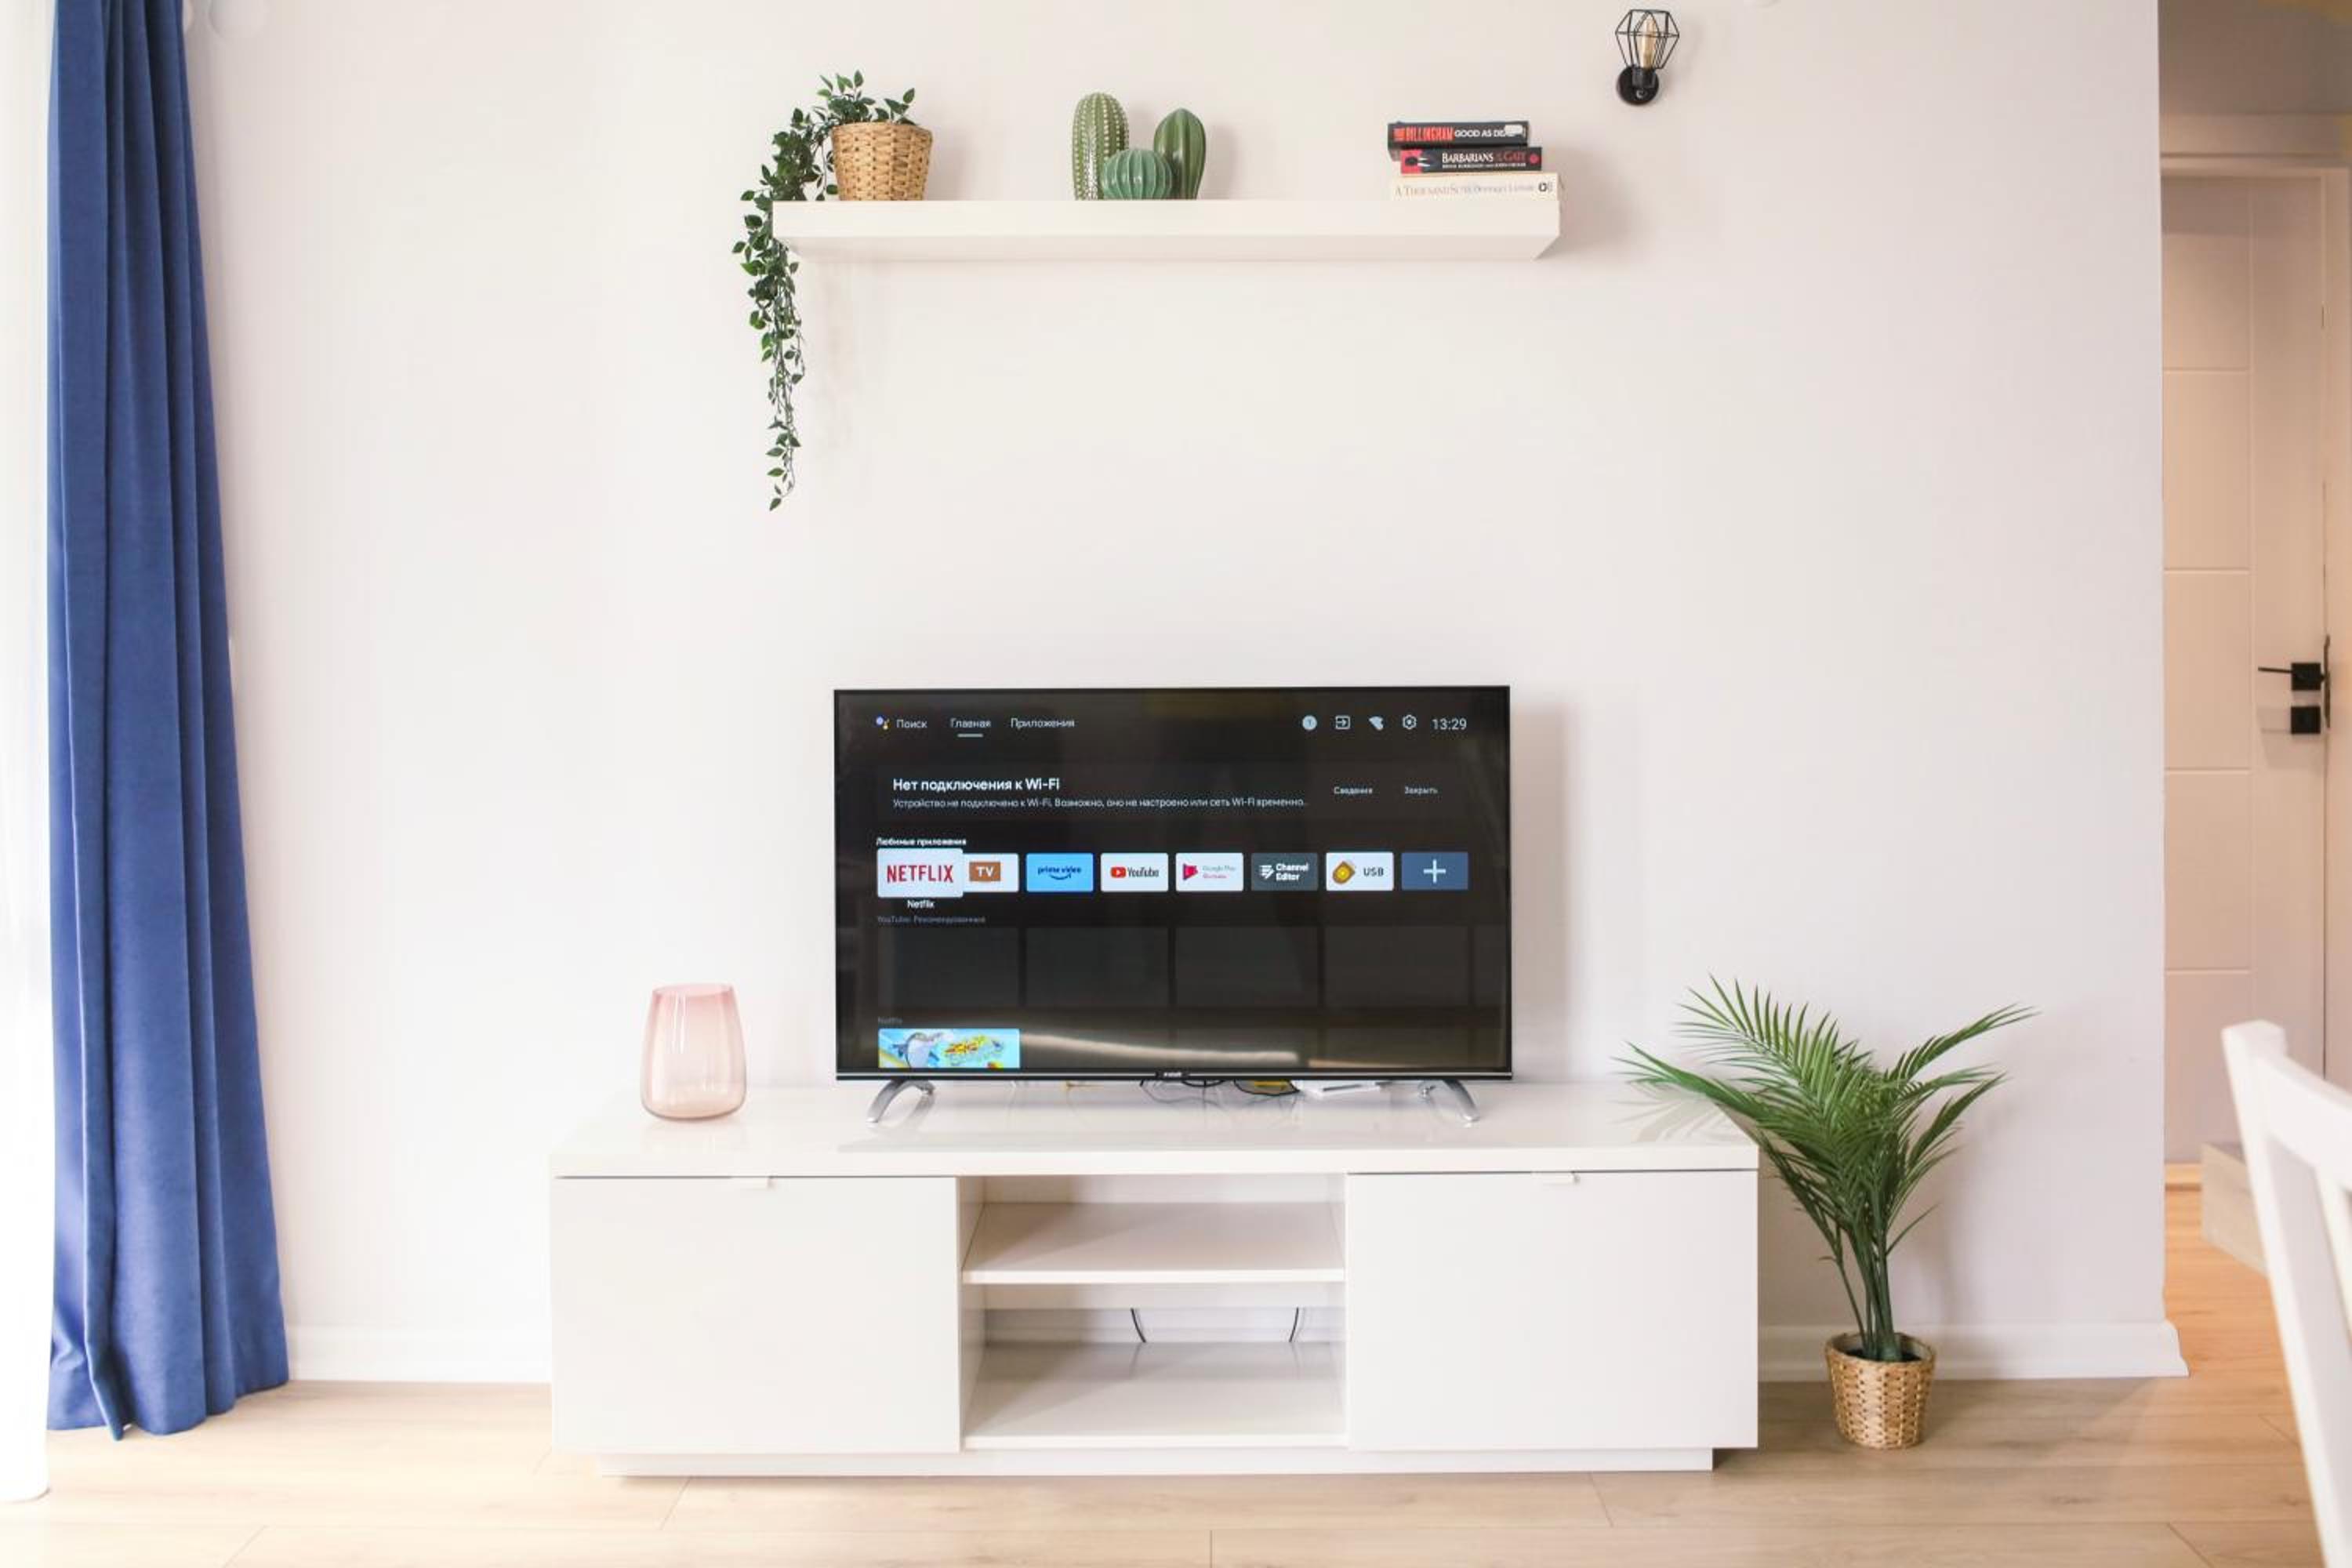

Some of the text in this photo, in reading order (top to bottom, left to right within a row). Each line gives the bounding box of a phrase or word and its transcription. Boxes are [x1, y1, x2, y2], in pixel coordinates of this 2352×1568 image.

[1454, 129, 1479, 137] GOOD
[1442, 153, 1494, 163] BARBARIANS
[896, 719, 927, 729] Поиск
[950, 718, 991, 728] Главная
[1010, 717, 1075, 730] Приложения
[1432, 718, 1468, 731] 13:29
[892, 778, 1060, 792] Нет подключения к Wi-Fi
[1334, 786, 1374, 796] Сведения
[1404, 786, 1438, 796] Закрыть
[892, 799, 948, 809] Устройство
[961, 799, 1018, 808] подключено
[1139, 799, 1189, 808] настроено
[1209, 799, 1230, 808] сеть
[1232, 797, 1254, 807] Wi-Fi
[916, 838, 967, 848] приложения
[977, 867, 994, 877] TV
[1037, 866, 1059, 876] prime
[1127, 866, 1160, 879] YouTube
[1276, 863, 1309, 872] Channel
[1363, 867, 1385, 877] USB
[887, 865, 954, 884] NETFLIX
[1276, 872, 1300, 881] Editor
[907, 900, 935, 909] Netflix
